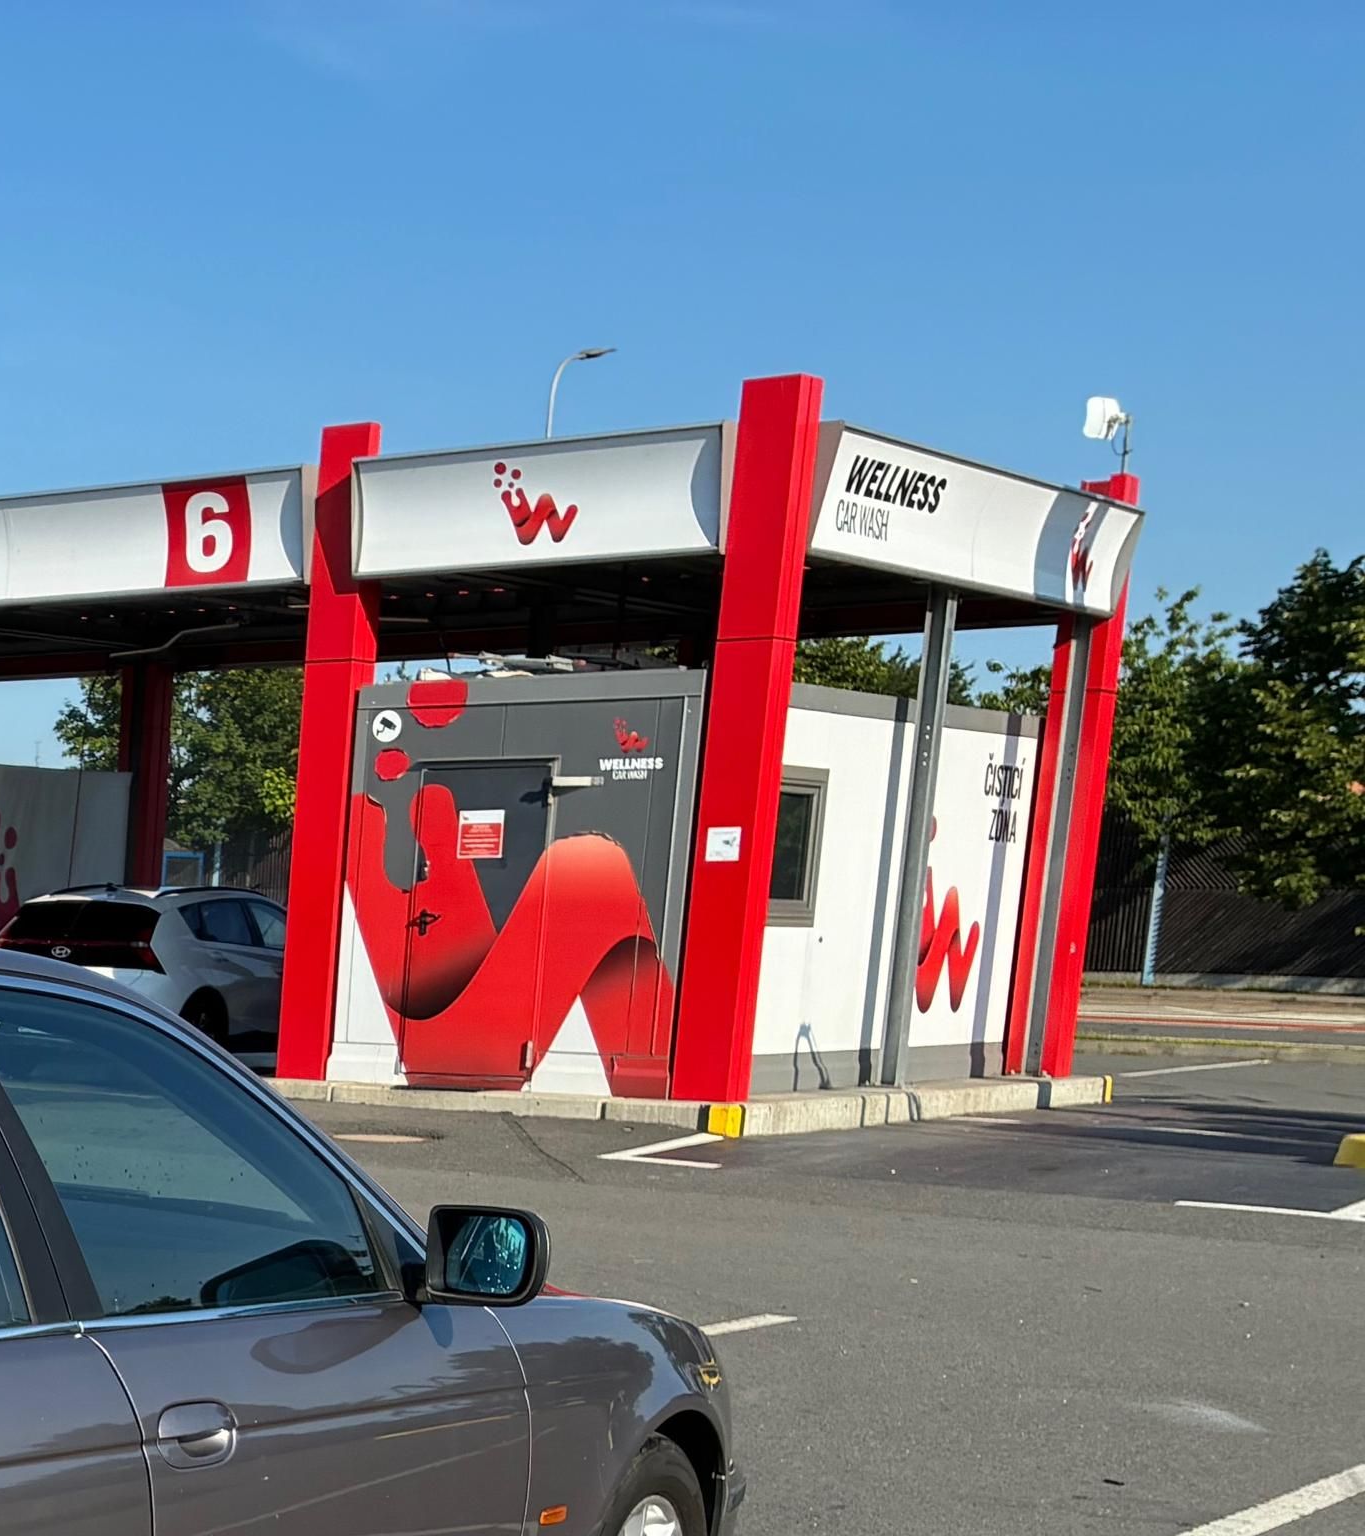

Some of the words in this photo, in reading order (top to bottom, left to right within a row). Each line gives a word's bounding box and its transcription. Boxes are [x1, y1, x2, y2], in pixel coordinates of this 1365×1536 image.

[845, 455, 947, 513] WELLNESS
[185, 491, 233, 573] 6
[835, 499, 857, 534] CAR
[859, 507, 891, 542] WASH
[599, 757, 663, 771] WELLNESS
[984, 753, 1026, 799] ČISTICÍ
[988, 801, 1018, 843] ZÓNA
